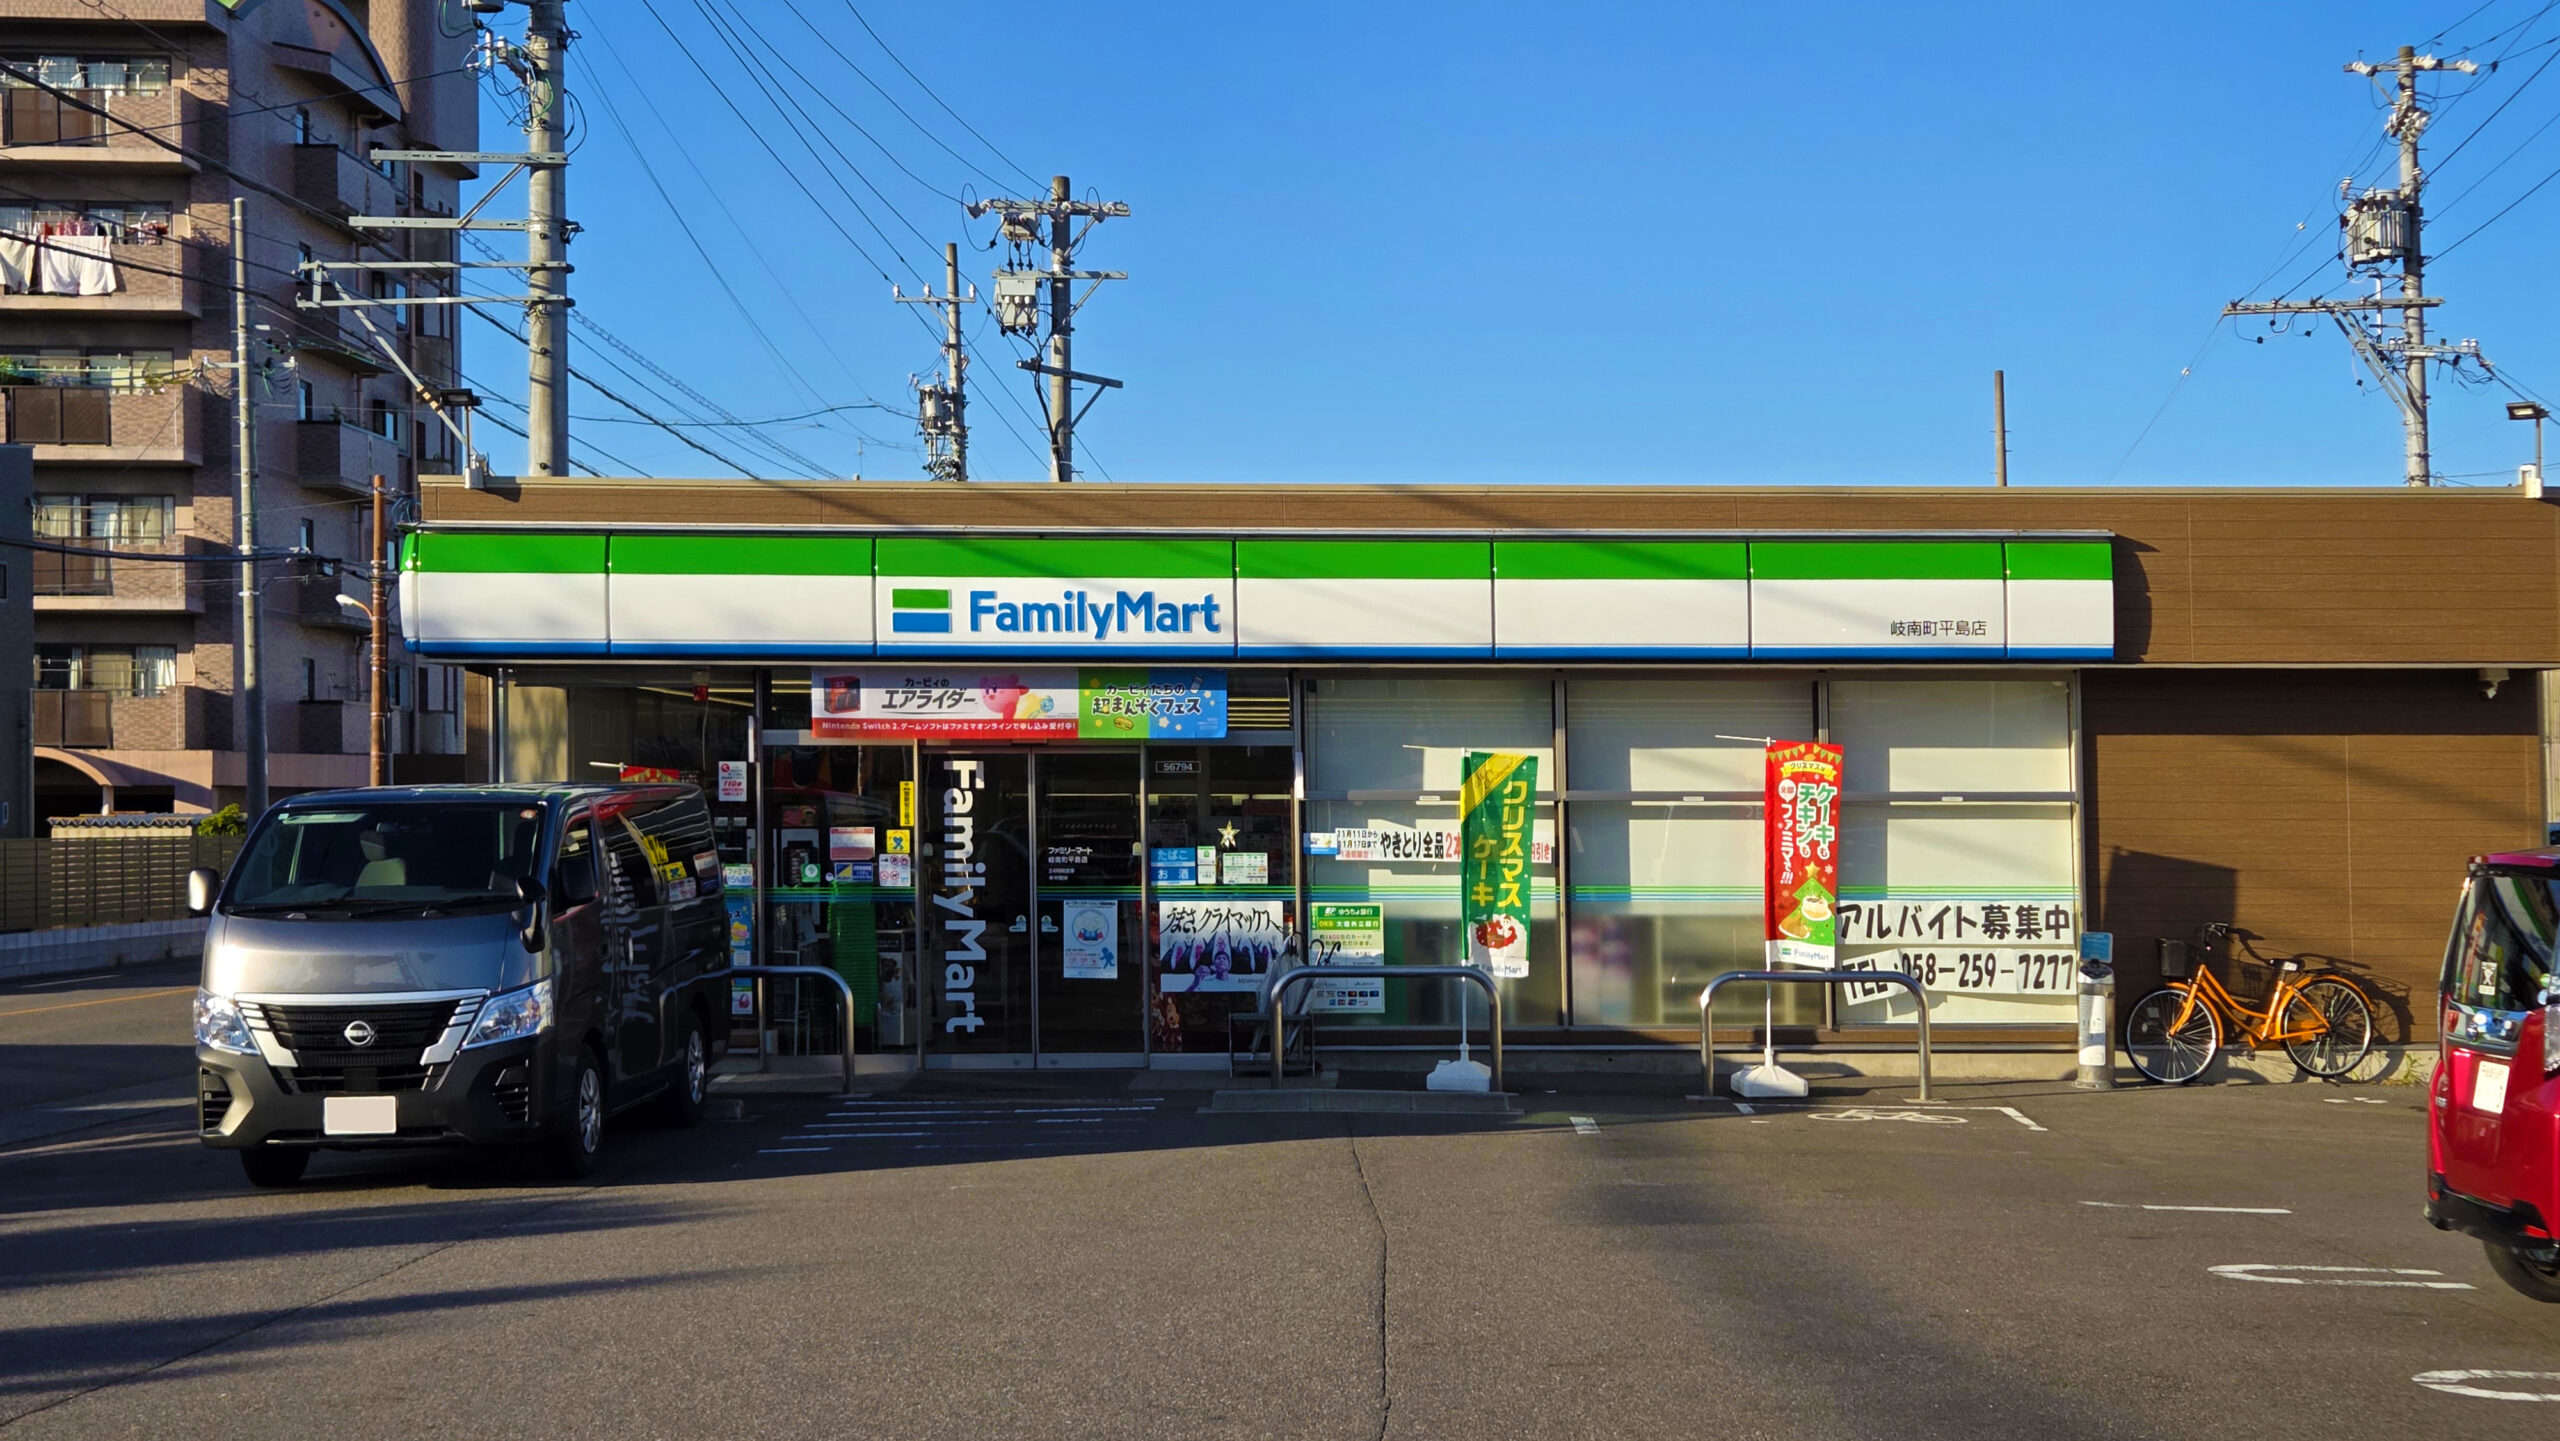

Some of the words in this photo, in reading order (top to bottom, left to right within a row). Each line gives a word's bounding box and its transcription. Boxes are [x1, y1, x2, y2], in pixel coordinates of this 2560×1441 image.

[970, 590, 1221, 639] FamilyMart
[1890, 620, 1987, 637] 岐南町平島店
[904, 677, 950, 688] カービィの
[1105, 683, 1186, 695] カービィたちの
[881, 688, 976, 710] エアライダー
[1092, 697, 1202, 715] 超まんぞくフェス
[822, 722, 860, 730] Nintendo
[862, 722, 891, 730] Switch
[1163, 763, 1193, 771] 56794
[1797, 782, 1817, 858] チキンも
[1815, 783, 1837, 859] ケーキも
[1048, 846, 1093, 855] ファミリーマート
[1337, 840, 1377, 848] 1月17日まで
[1380, 831, 1462, 859] やきとり全品2本
[1498, 781, 1528, 908] クリスマス
[1157, 849, 1189, 860] たばこ
[1471, 835, 1498, 908] ケーキ
[933, 760, 987, 1033] FamilyMart
[1338, 907, 1373, 916] ゆうちょ銀行
[1836, 903, 2070, 940] アルバイト募集中
